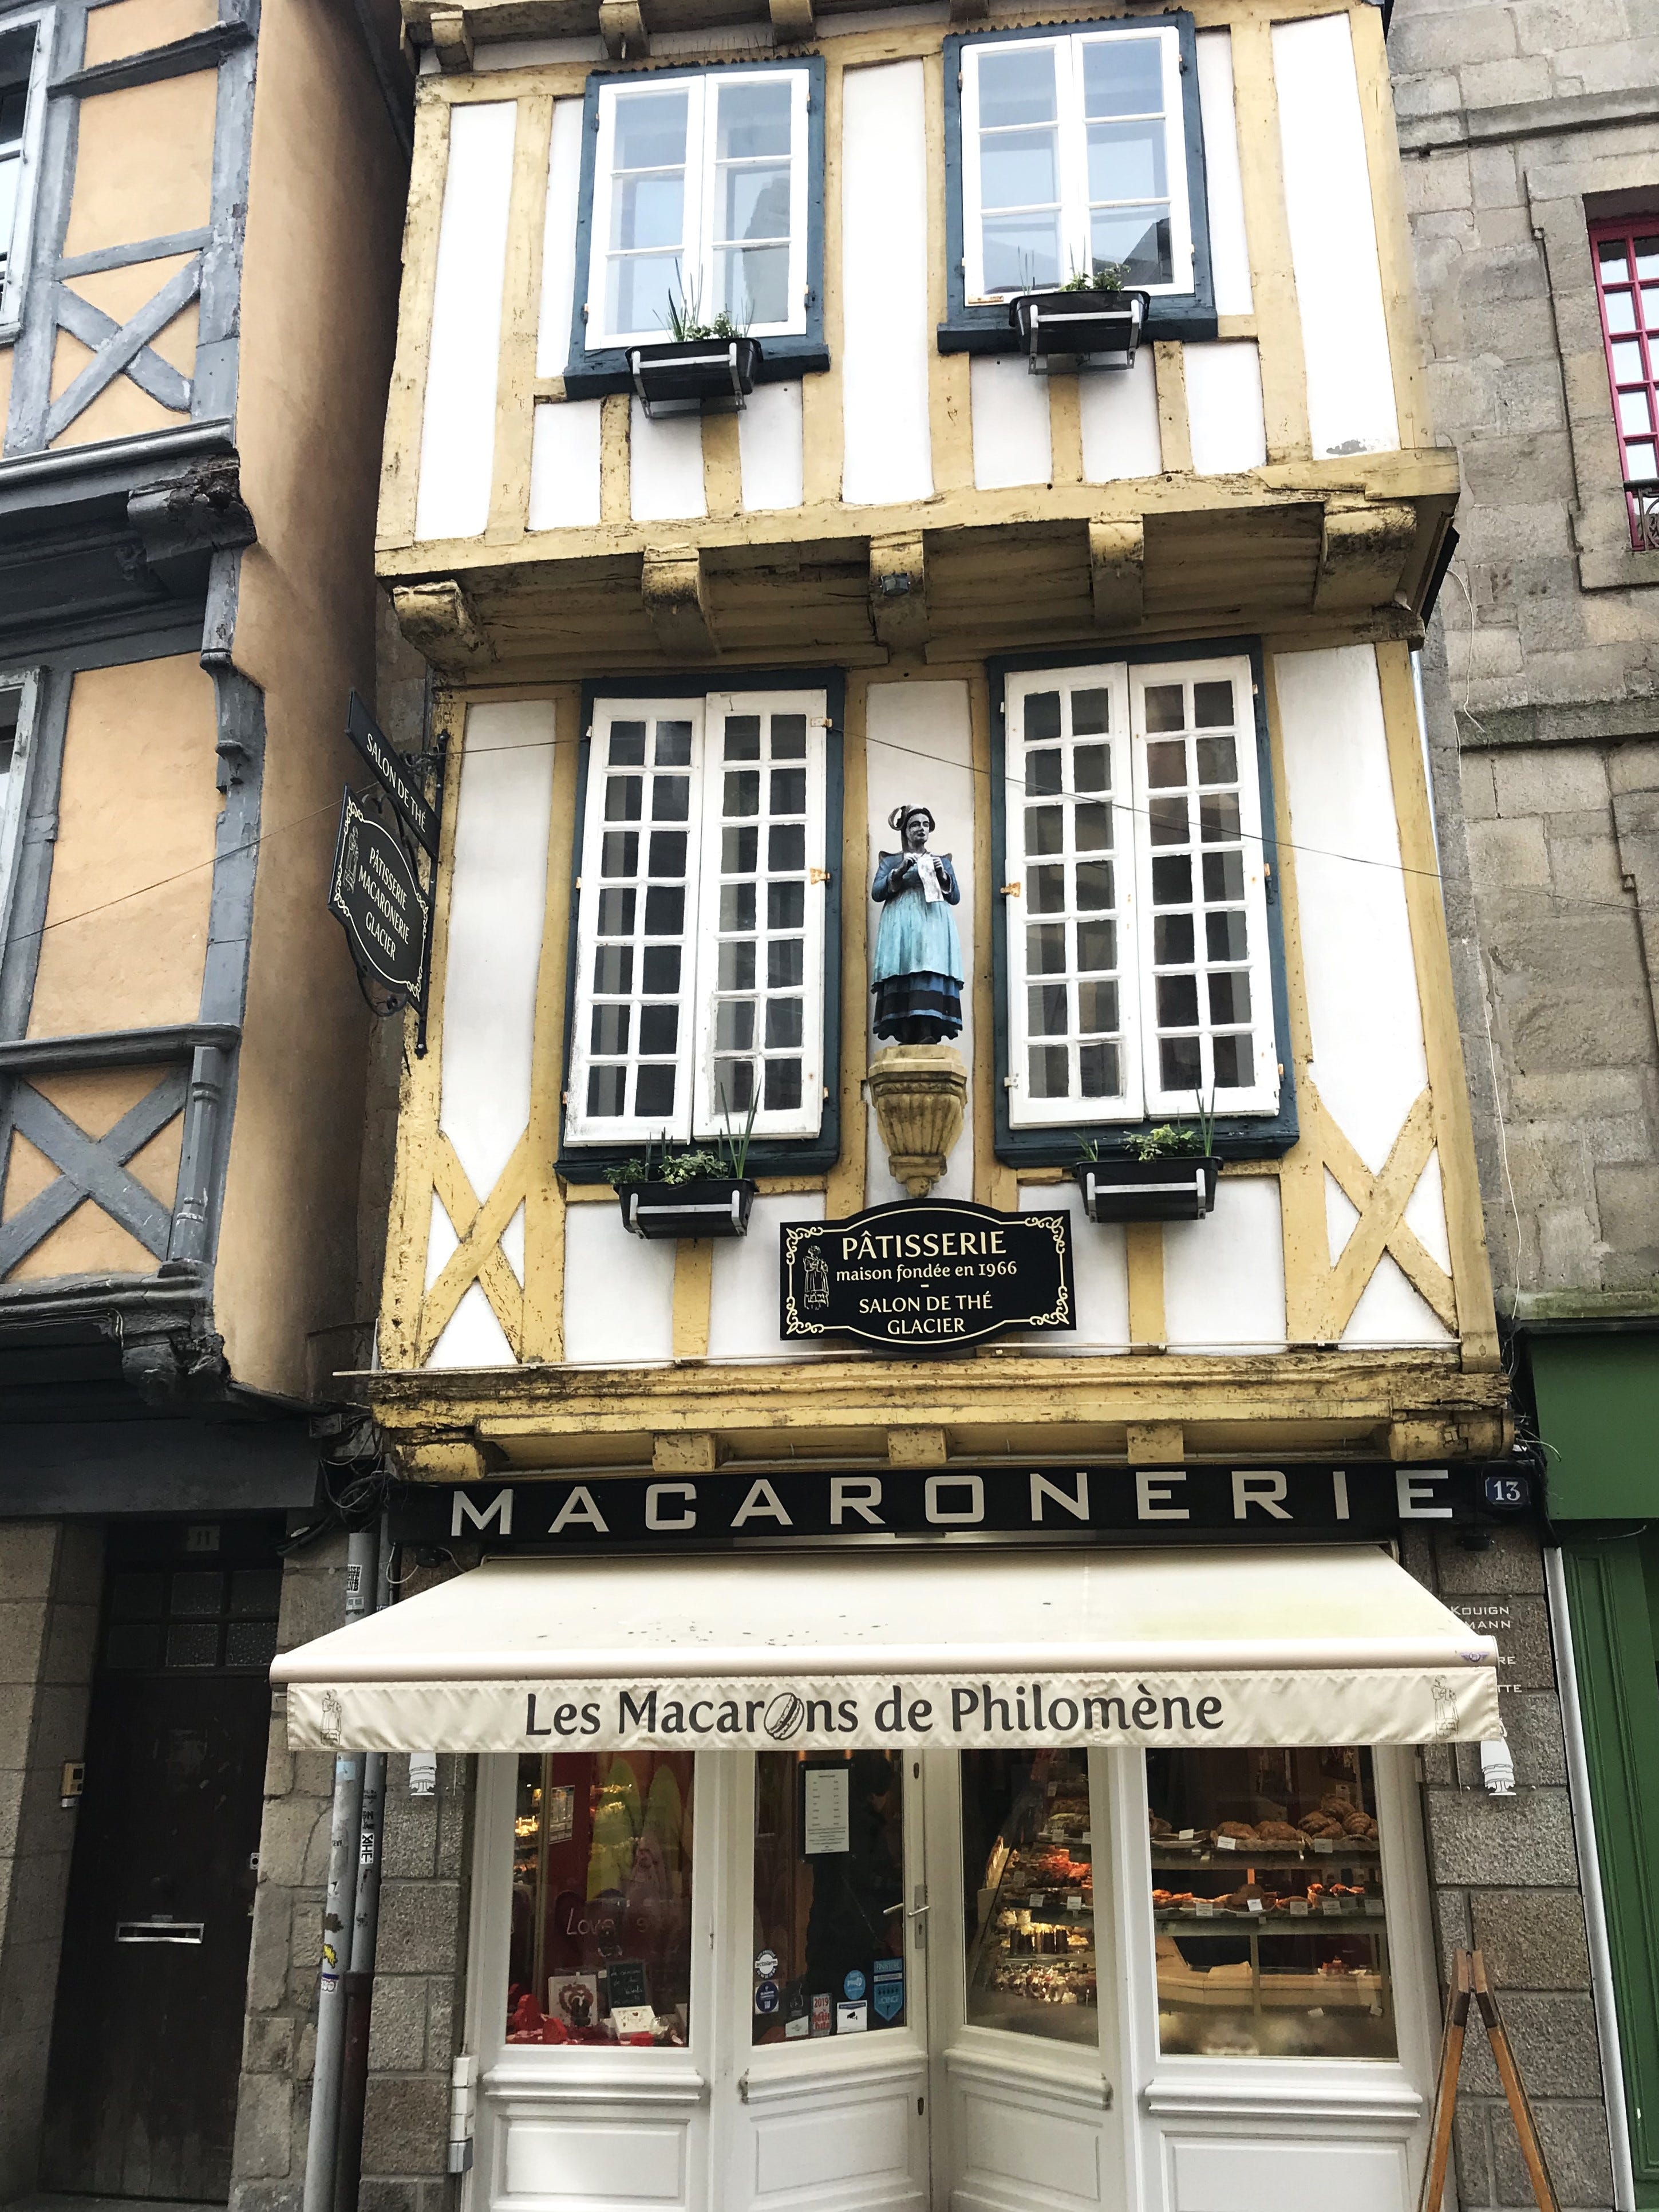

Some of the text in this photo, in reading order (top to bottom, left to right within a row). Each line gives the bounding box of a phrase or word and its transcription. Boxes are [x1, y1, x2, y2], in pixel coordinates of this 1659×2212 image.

[367, 734, 426, 833] SALON DE THÉ
[369, 847, 407, 910] PÂTISSERIE
[358, 865, 410, 945] MACARONERIE
[366, 912, 396, 961] GLACIER
[842, 1230, 1007, 1260] PÂTISSERIE
[836, 1261, 1017, 1283] maison fondée en 1966
[859, 1290, 993, 1314] SALON DE THÉ
[887, 1318, 966, 1335] GLACIER
[451, 1469, 1453, 1536] MACARONERIE
[1494, 1481, 1520, 1501] 13
[1451, 1606, 1510, 1615] KOUIGN
[1464, 1620, 1511, 1629] MANN
[526, 1693, 601, 1736] Les
[874, 1685, 934, 1732] de
[951, 1683, 1224, 1732] Philomène
[814, 1997, 829, 2008] 2019
